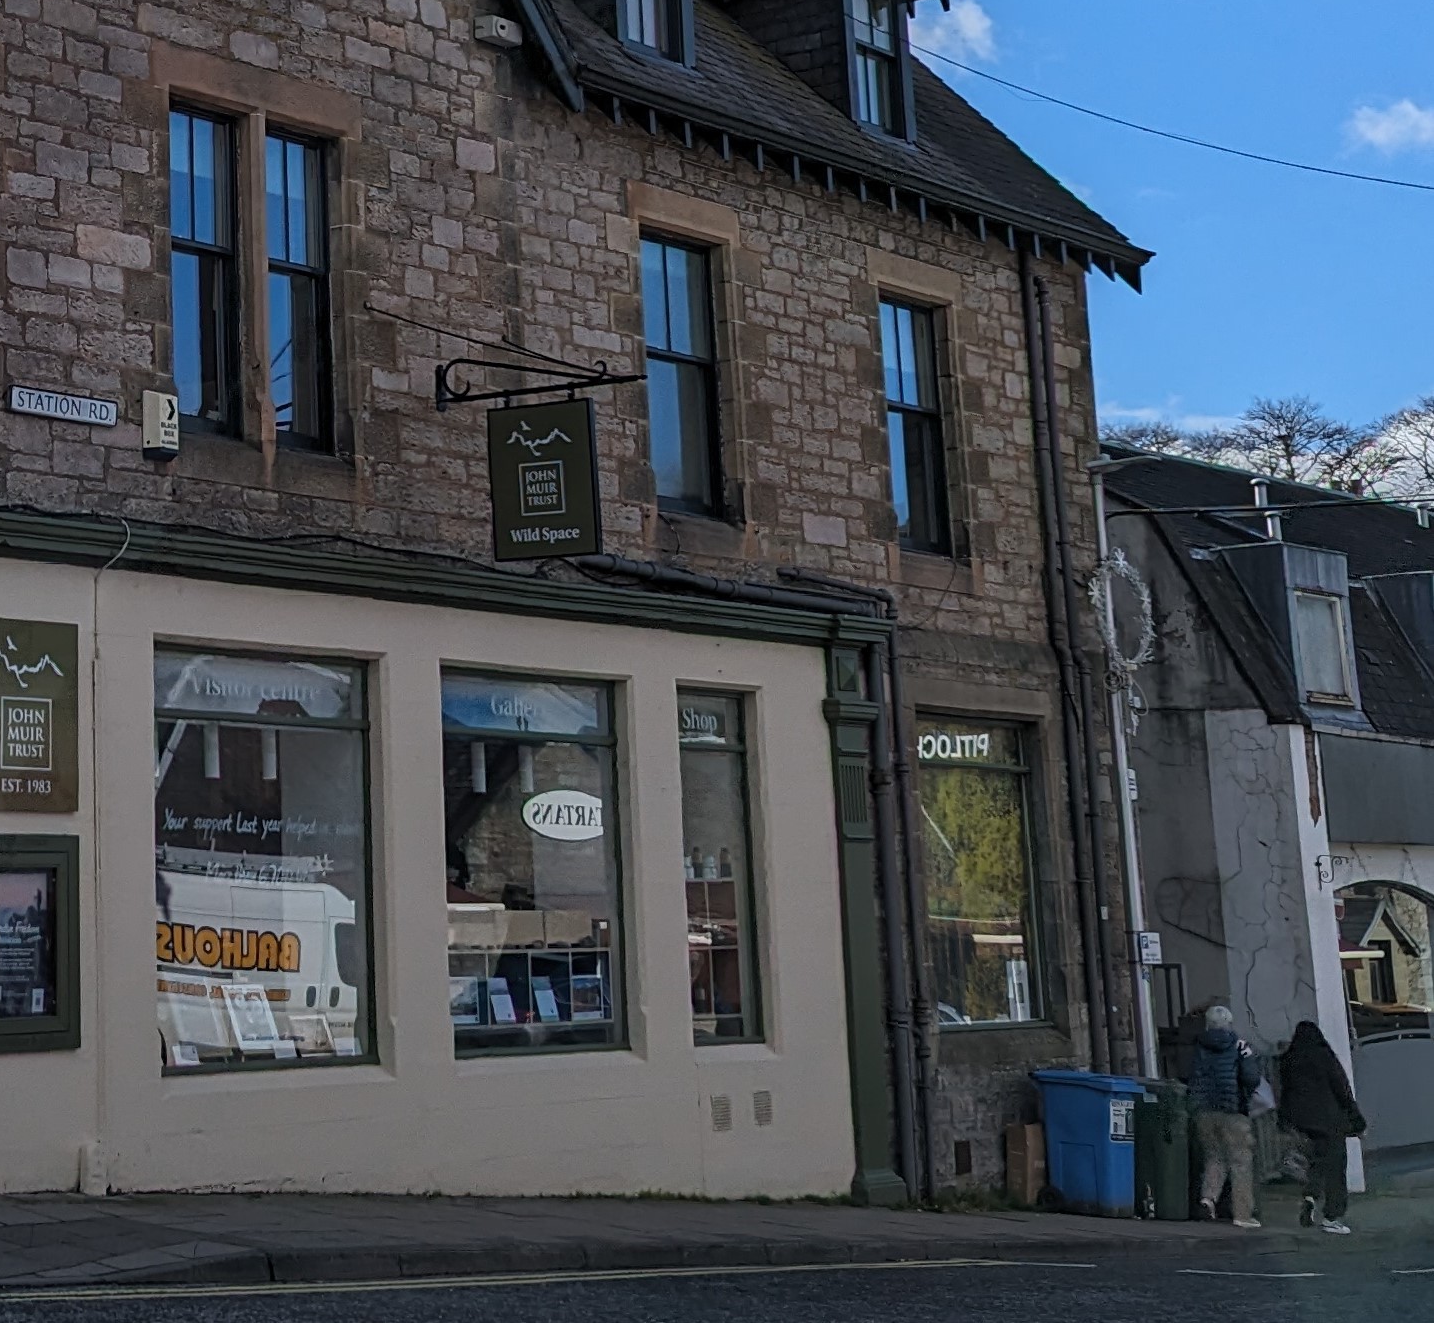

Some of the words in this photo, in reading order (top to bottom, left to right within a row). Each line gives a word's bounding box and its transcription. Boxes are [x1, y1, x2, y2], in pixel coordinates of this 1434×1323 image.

[17, 390, 82, 417] STATION
[88, 403, 112, 422] RD.
[525, 469, 557, 484] JOHN
[525, 482, 558, 495] MUIR
[526, 494, 558, 507] TRUST
[510, 528, 540, 543] Wild
[542, 526, 581, 544] Space
[7, 707, 45, 726] JOHN
[681, 707, 717, 731] Shop
[7, 726, 45, 742] MUIR
[7, 743, 45, 758] TRUST
[1, 777, 24, 793] EST.
[27, 779, 52, 794] 1983
[162, 807, 189, 831] Your
[194, 813, 233, 841] support
[261, 818, 281, 841] year
